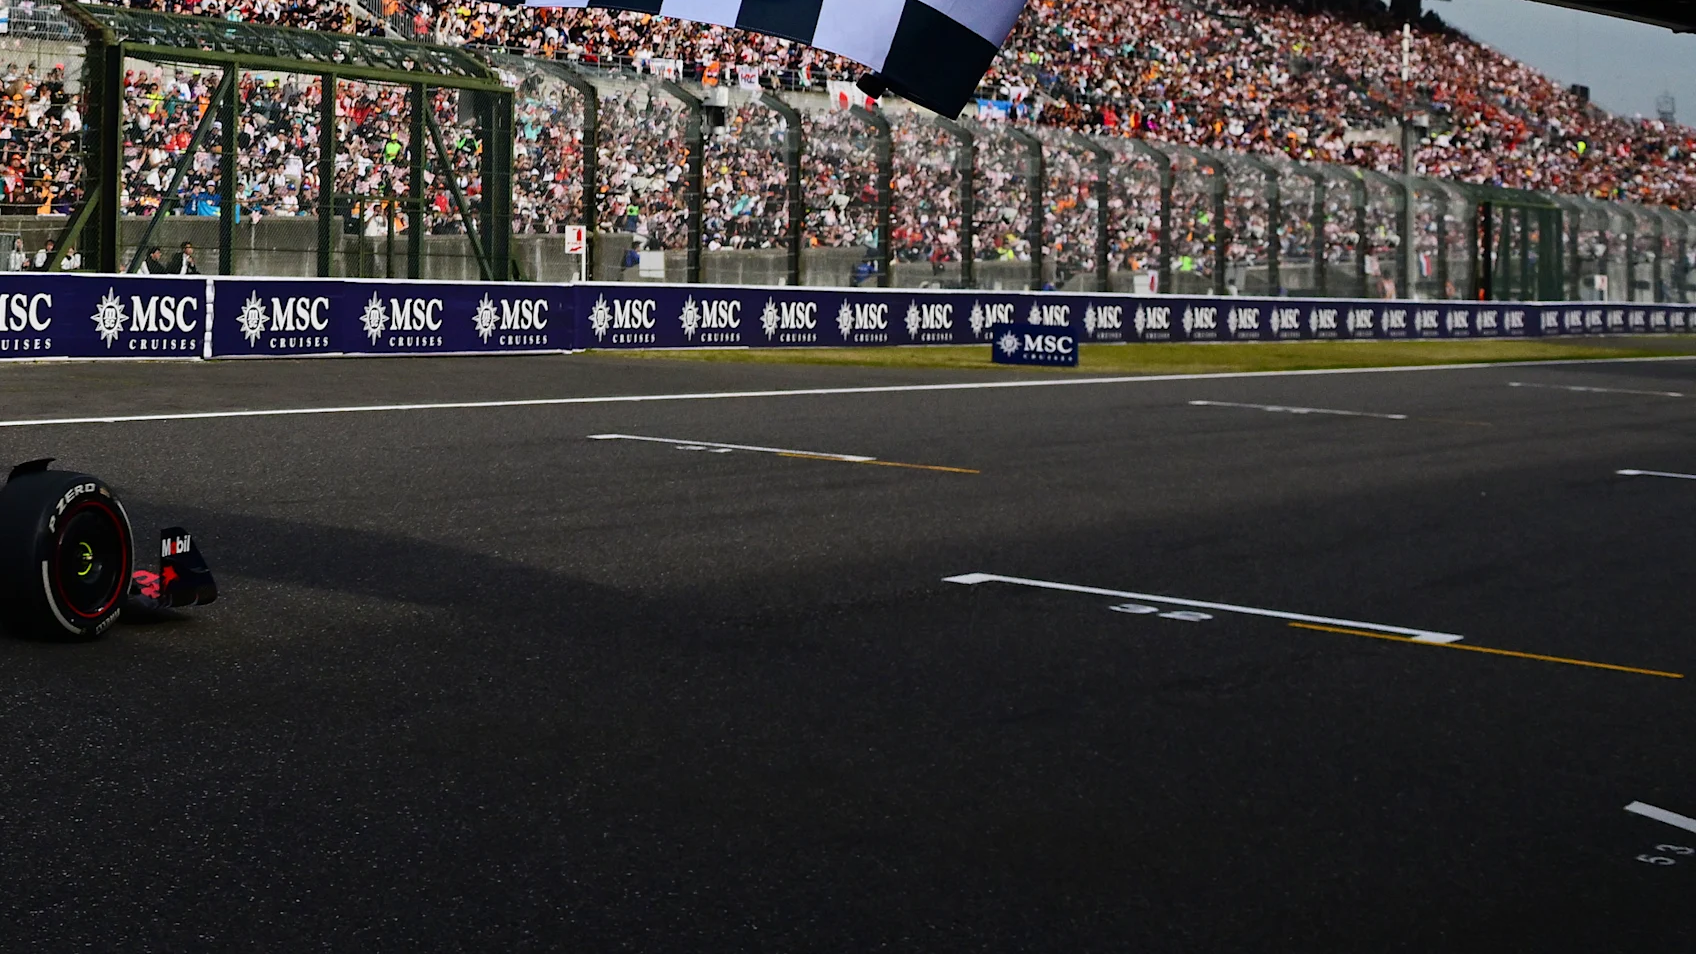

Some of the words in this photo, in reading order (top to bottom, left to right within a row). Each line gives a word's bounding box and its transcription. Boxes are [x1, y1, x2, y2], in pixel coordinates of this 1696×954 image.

[128, 296, 197, 332] MSC
[269, 297, 329, 331] MSC
[388, 299, 442, 330] MSC
[498, 299, 548, 329] MSC
[611, 299, 655, 328] MSC
[699, 300, 740, 328] MSC
[778, 302, 816, 329] MSC
[852, 304, 888, 329] MSC
[920, 304, 952, 329] MSC
[129, 339, 195, 349] CRUISES
[270, 337, 328, 348] CRUISES
[389, 337, 442, 346] CRUISES
[500, 335, 547, 345] CRUISES
[613, 334, 655, 343] CRUISES
[1024, 334, 1073, 354] MSC
[55, 482, 96, 516] ZERO
[161, 534, 191, 558] Mobil
